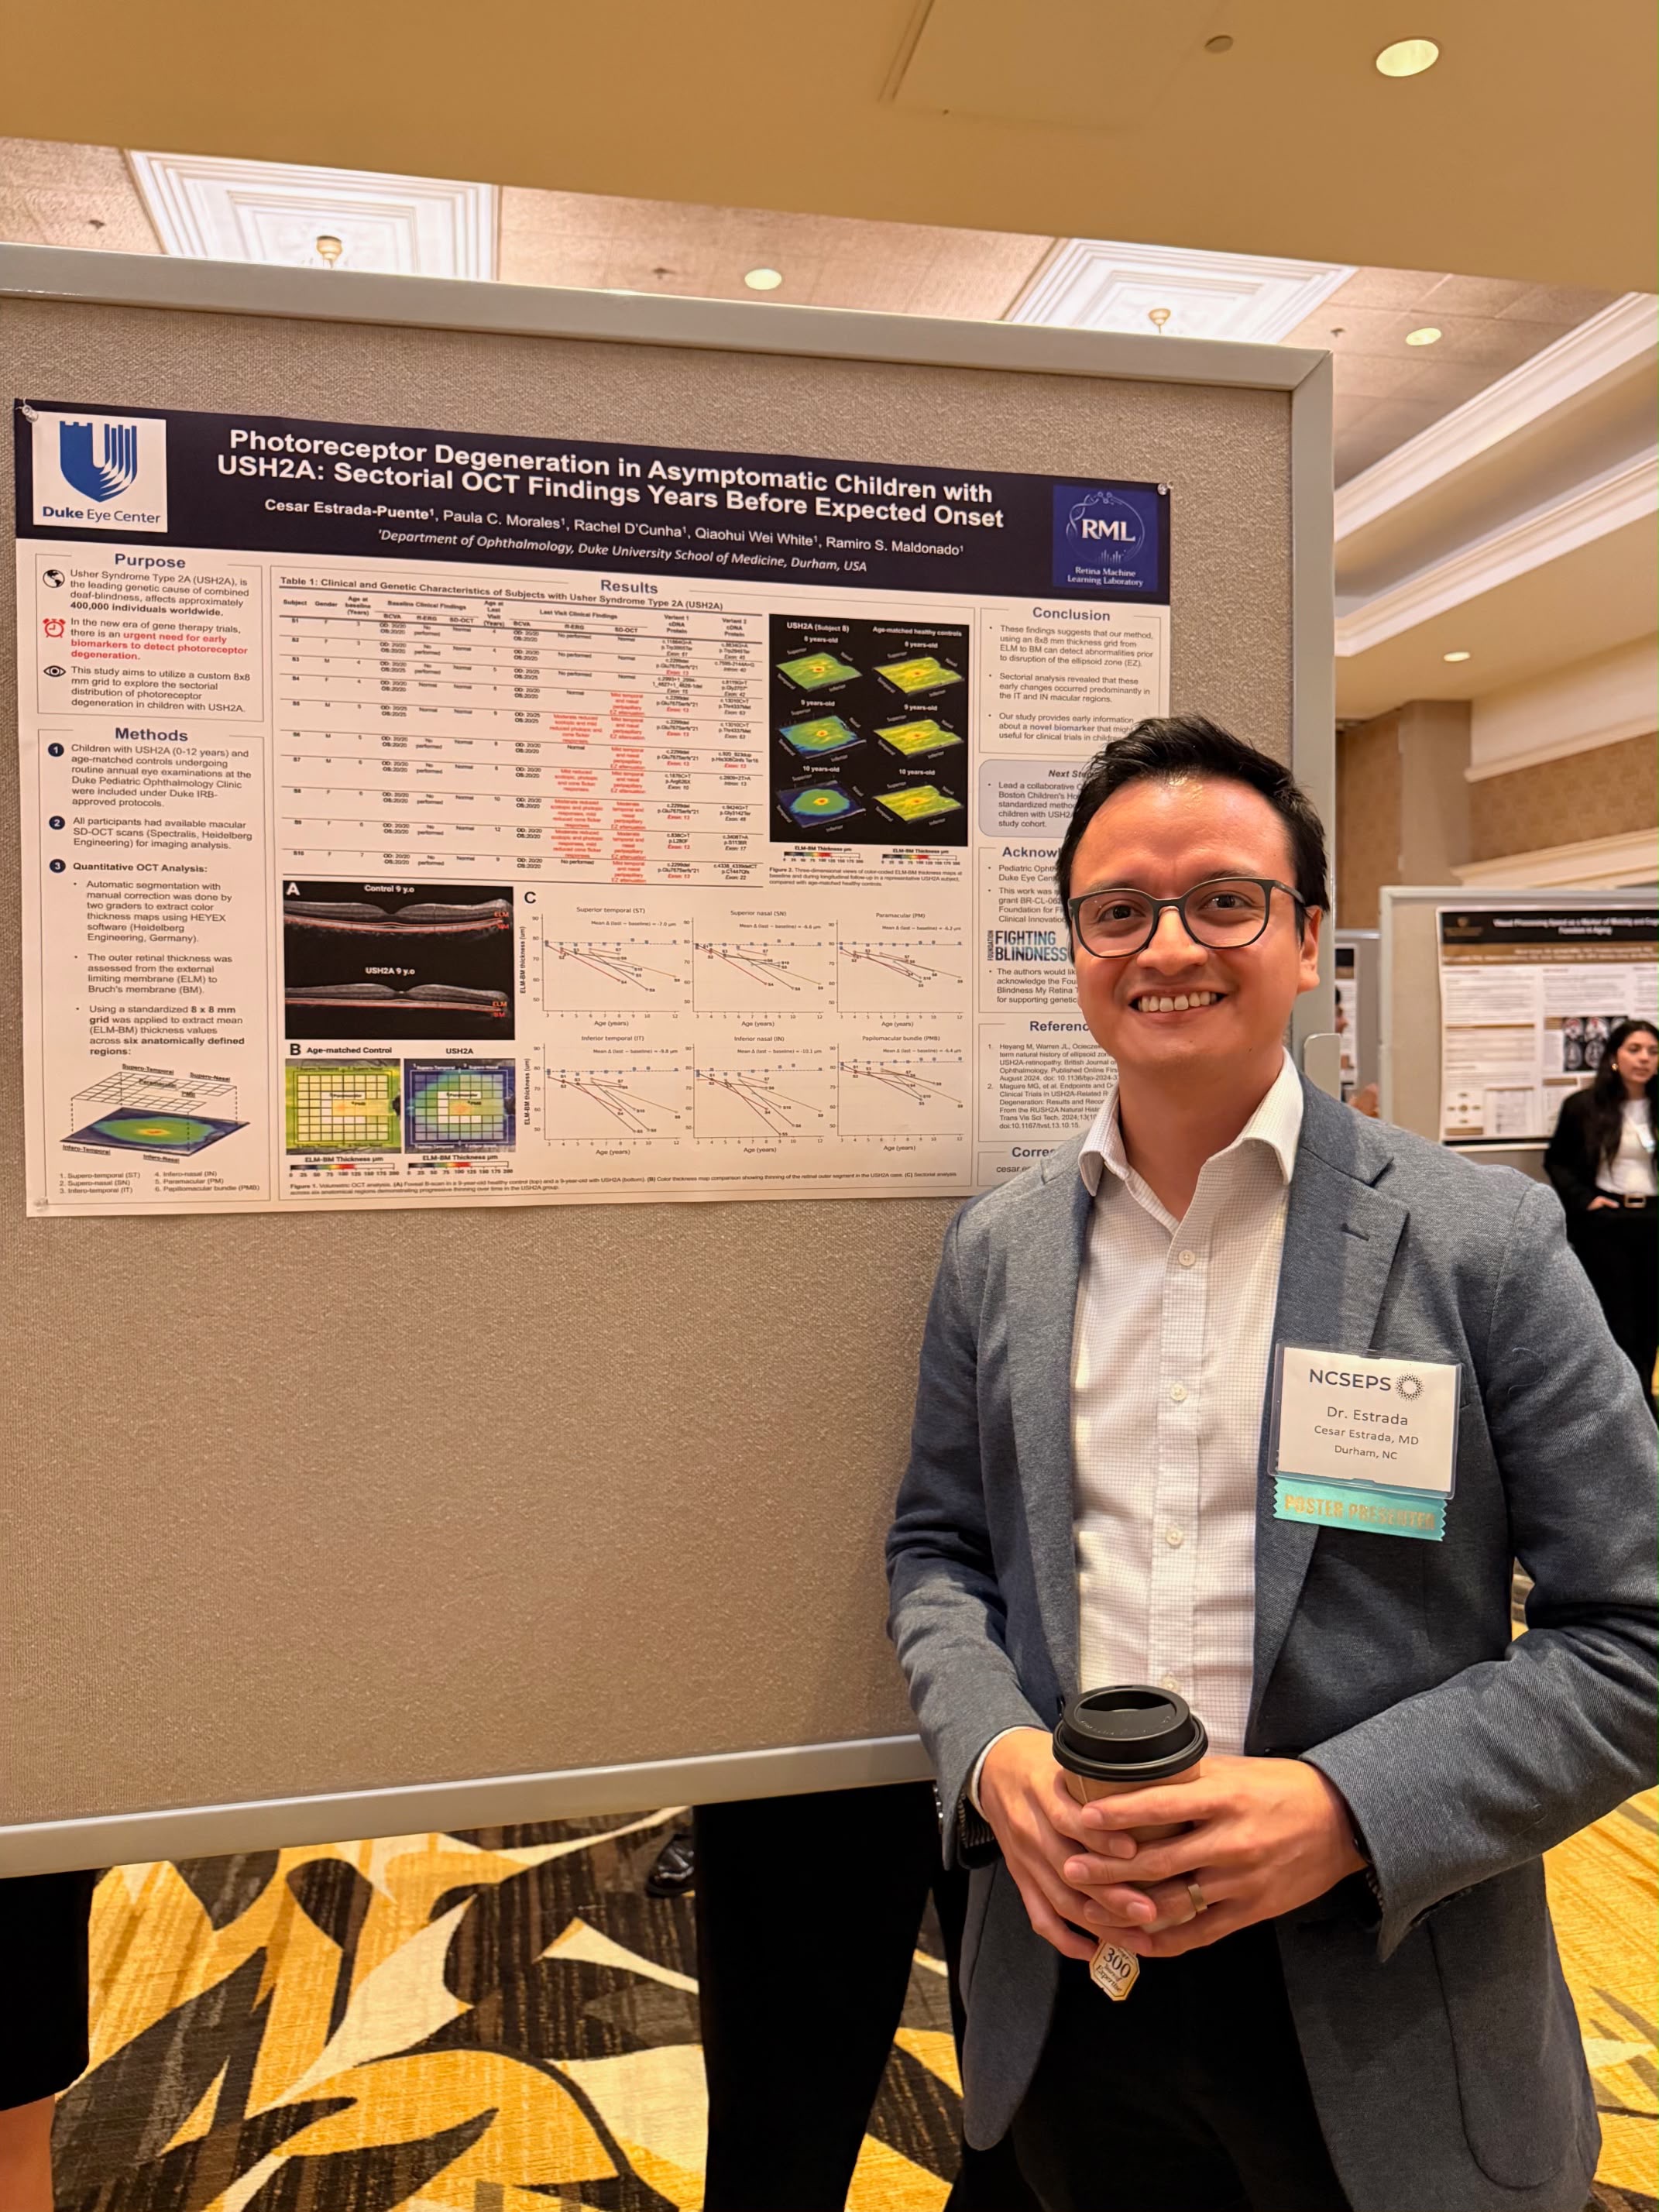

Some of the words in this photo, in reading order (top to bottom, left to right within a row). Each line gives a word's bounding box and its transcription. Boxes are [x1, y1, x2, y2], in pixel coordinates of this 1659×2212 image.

[231, 429, 428, 464] Photoreceptor
[435, 444, 610, 476] Degeneration
[619, 458, 641, 478] in
[647, 460, 828, 492] Asymptomatic
[835, 473, 936, 500] Children
[943, 483, 992, 503] with
[218, 454, 324, 480] USH2A:
[334, 462, 453, 489] Sectorial
[462, 471, 520, 494] OCT
[528, 476, 641, 507] Findings
[647, 484, 719, 508] Years
[726, 489, 808, 515] Before
[816, 496, 926, 523] Expected
[934, 505, 1004, 528] Onset
[43, 506, 84, 520] Duke
[87, 509, 112, 523] Eye
[114, 510, 161, 524] Center
[265, 499, 311, 513] Cesar
[443, 510, 483, 524] Paula
[486, 513, 502, 525] C.
[574, 519, 620, 534] Rachel
[695, 527, 745, 542] Qiaohui
[748, 531, 774, 544] Wei
[826, 536, 871, 551] Ramiro
[874, 539, 888, 551] S.
[1082, 519, 1135, 542] RML
[461, 534, 476, 548] of
[477, 536, 575, 555] Ophthalmology,
[578, 543, 610, 555] Duke
[612, 545, 672, 562] University
[674, 549, 714, 562] School
[716, 552, 730, 565] of
[731, 553, 788, 568] Medicine,
[791, 557, 840, 572] Durham,
[844, 561, 867, 572] USA
[115, 553, 186, 570] Purpose
[70, 568, 99, 579] Usher
[101, 571, 150, 582] Syndrome
[152, 573, 176, 584] Type
[178, 575, 191, 583] 2A
[193, 575, 238, 587] (USH2A),
[1075, 566, 1101, 575] Retina
[1103, 568, 1136, 579] Machine
[70, 580, 86, 592] the
[88, 581, 123, 592] leading
[125, 584, 160, 592] genetic
[192, 586, 202, 595] of
[204, 588, 249, 597] combined
[600, 579, 658, 594] Results
[1067, 575, 1102, 586] Learning
[1103, 576, 1144, 588] Laboratory
[70, 591, 142, 602] deaf-blindness,
[145, 594, 177, 604] affects
[178, 597, 244, 609] approximately
[280, 577, 306, 586] Table
[321, 579, 357, 588] Clinical
[359, 581, 379, 589] and
[380, 582, 417, 592] Genetic
[420, 584, 490, 595] Characteristics
[505, 589, 546, 600] Subjects
[569, 593, 597, 603] Usher
[599, 595, 646, 606] Syndrome
[647, 598, 669, 608] Type
[672, 599, 684, 608] 2A
[685, 601, 723, 611] (USH2A)
[70, 601, 109, 611] 400,000
[112, 603, 167, 613] individuals
[170, 607, 224, 617] worldwide.
[1032, 606, 1111, 622] Conclusion
[70, 617, 80, 626] In
[82, 618, 98, 627] the
[140, 621, 150, 630] of
[152, 623, 177, 631] gene
[178, 623, 214, 634] therapy
[216, 625, 241, 634] trials,
[1000, 624, 1025, 634] These
[1025, 626, 1056, 637] findings
[1057, 629, 1091, 637] suggests
[1123, 631, 1153, 640] method,
[98, 630, 106, 638] is
[123, 633, 156, 641] urgent
[186, 634, 201, 642] for
[202, 635, 228, 645] early
[71, 641, 127, 649] biomarkers
[143, 642, 175, 651] detect
[177, 644, 249, 655] photoreceptor
[71, 651, 139, 660] degeneration.
[115, 727, 188, 742] Methods
[53, 746, 59, 754] 1
[53, 819, 60, 827] 2
[998, 820, 1020, 829] study
[54, 862, 61, 871] 3
[73, 863, 133, 872] Quantitative
[136, 863, 159, 872] OCT
[161, 864, 208, 874] Analysis:
[286, 882, 301, 896] A
[364, 884, 394, 893] Control
[403, 885, 415, 894] y.o
[524, 891, 537, 904] C
[995, 931, 1056, 946] FIGHTING
[995, 947, 1067, 961] BLINDNESS
[366, 967, 395, 975] USH2A
[290, 1043, 301, 1056] B
[1310, 1369, 1392, 1392] NCSEPS
[1328, 1407, 1348, 1419] Dr.
[1353, 1409, 1408, 1426] Estrada
[1314, 1425, 1346, 1437] Cesar
[1349, 1429, 1395, 1444] Estrada,
[1399, 1434, 1419, 1445] MD
[1334, 1444, 1379, 1459] Durham,
[1382, 1450, 1398, 1461] NC
[1285, 1494, 1344, 1518] POSTER
[1348, 1503, 1435, 1531] PRESENTER
[1103, 1947, 1131, 1978] 300
